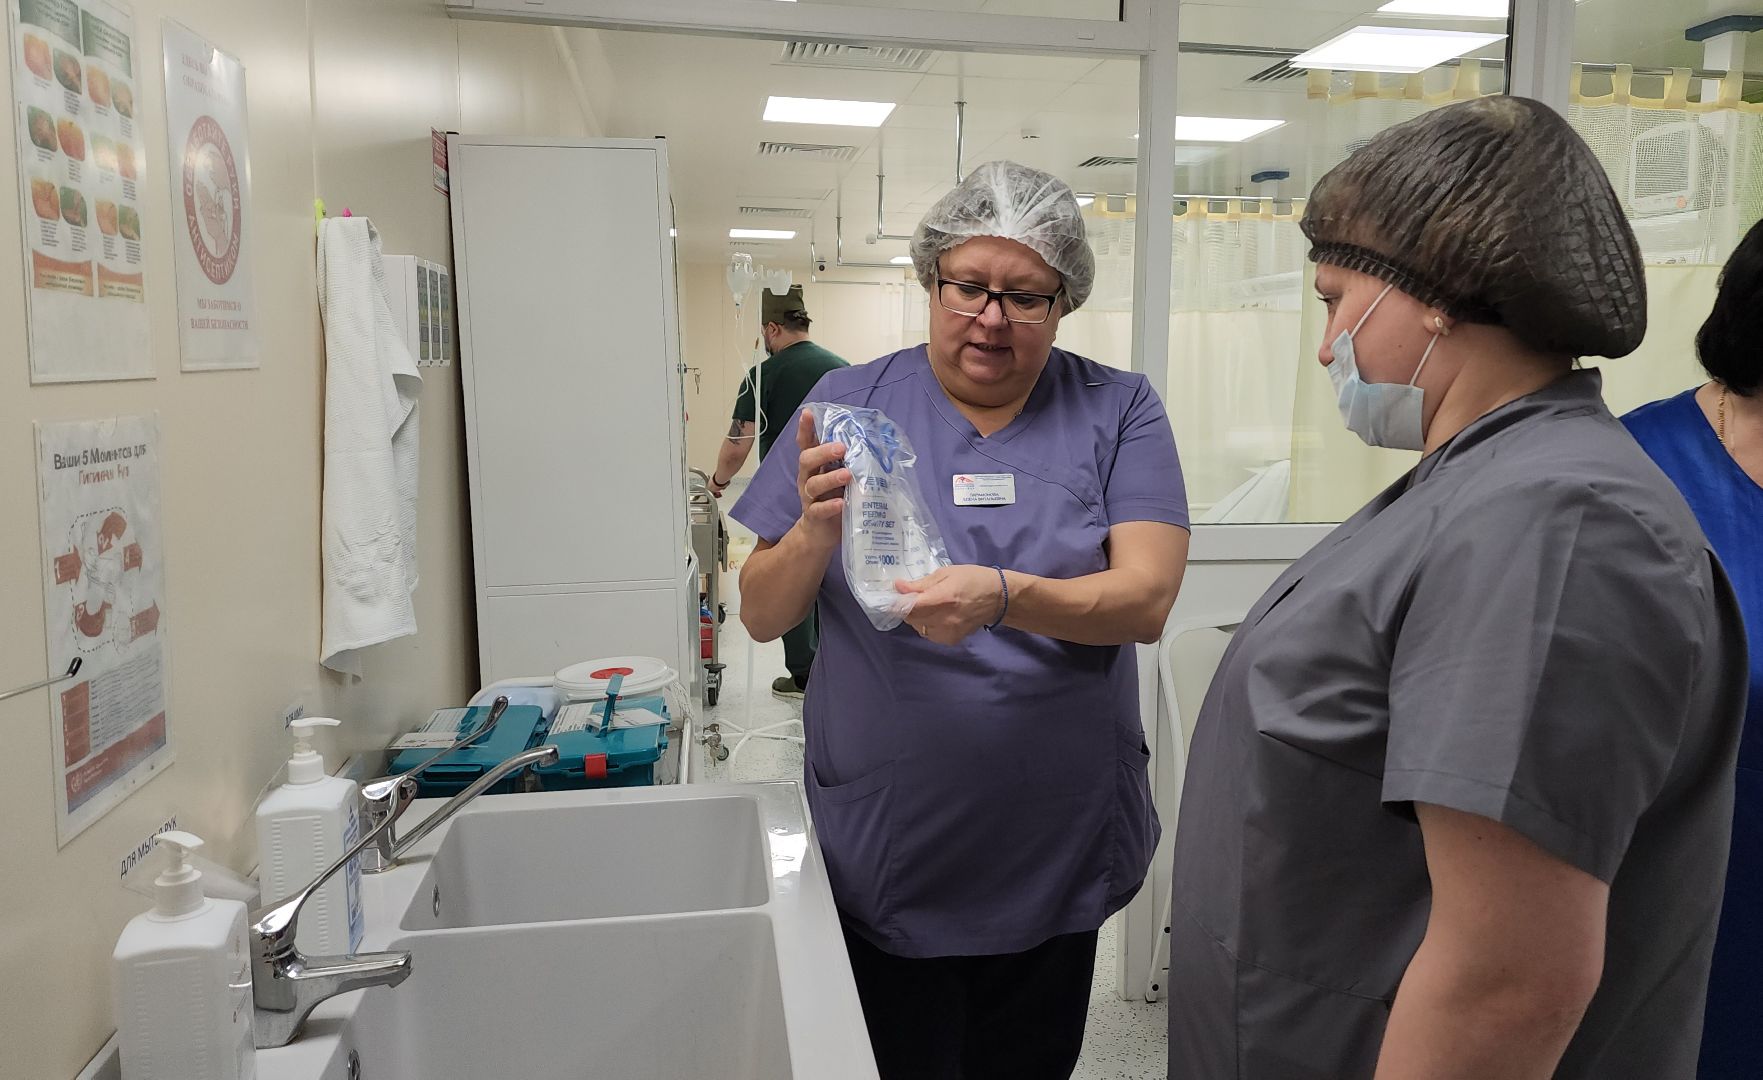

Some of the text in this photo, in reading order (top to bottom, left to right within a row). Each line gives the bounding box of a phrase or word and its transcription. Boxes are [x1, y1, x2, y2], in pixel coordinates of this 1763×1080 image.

[53, 452, 81, 470] Ваши
[82, 449, 89, 466] 5
[120, 850, 137, 880] ДЛЯ
[164, 813, 177, 833] РУК
